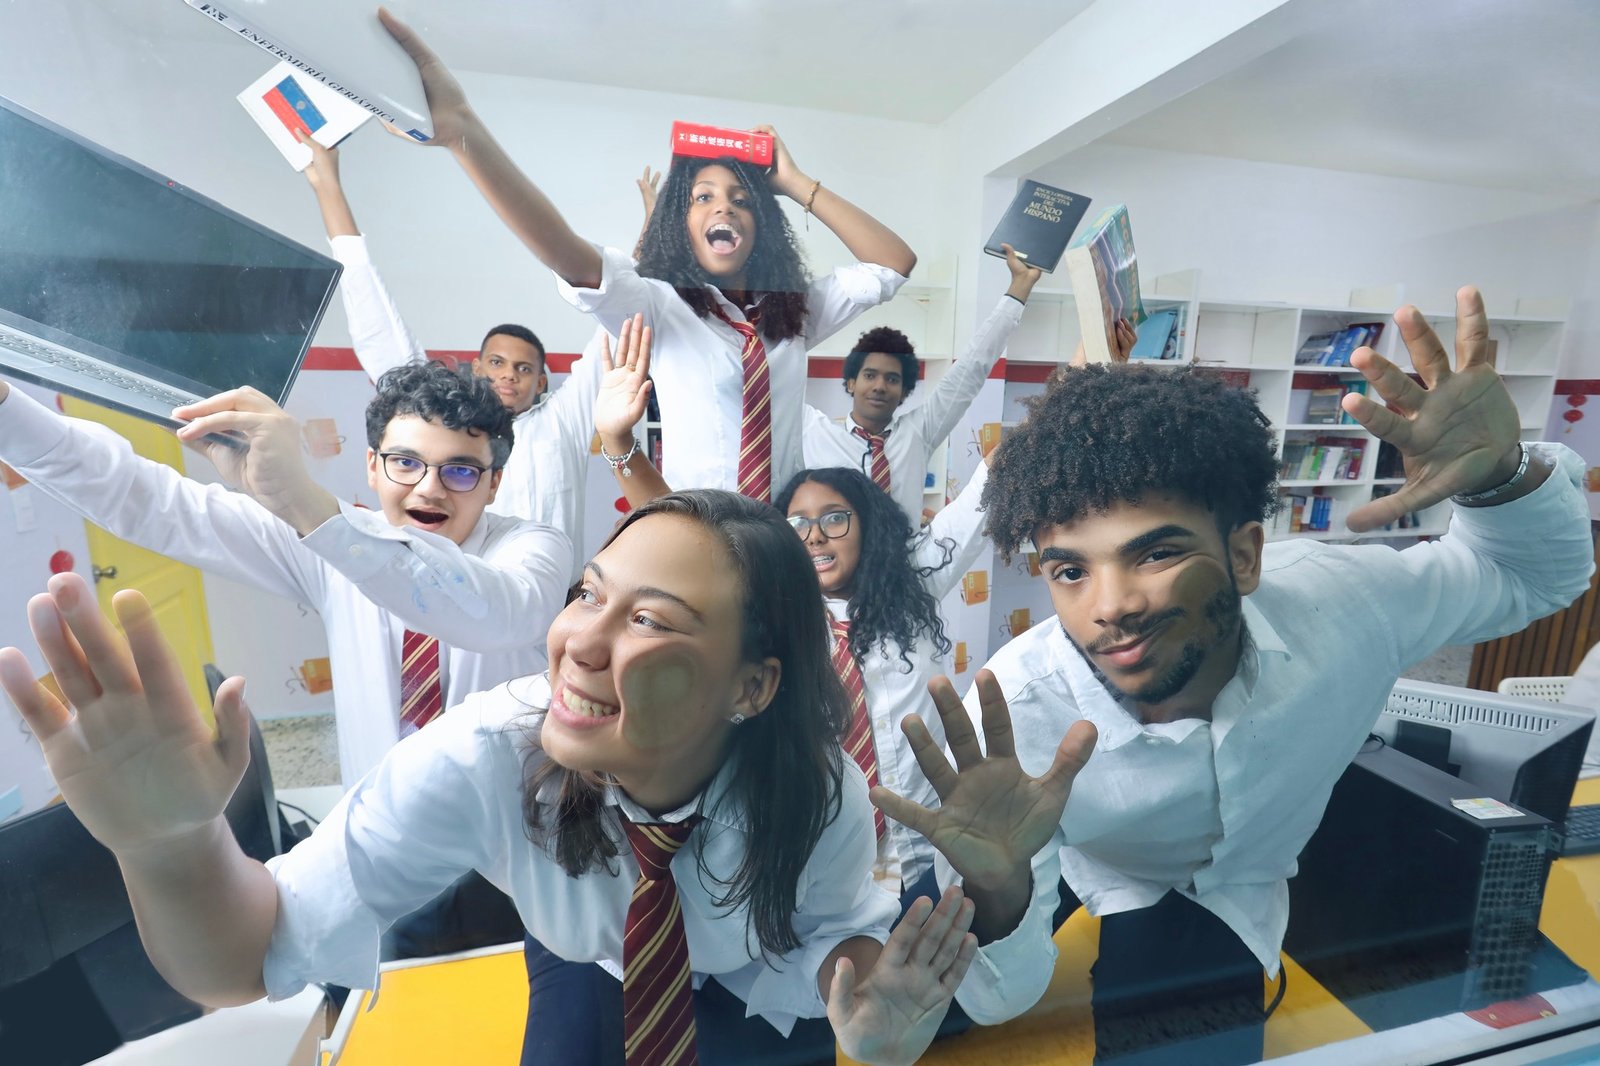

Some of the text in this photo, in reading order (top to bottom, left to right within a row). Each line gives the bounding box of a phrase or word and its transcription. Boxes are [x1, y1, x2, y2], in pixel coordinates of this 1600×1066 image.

[239, 27, 396, 124] ENFERMERÍA GERIÁTRICA
[689, 133, 744, 150] 新华成语词典
[1033, 190, 1070, 206] INTERACTIVA
[1043, 199, 1055, 207] DEL
[1023, 206, 1061, 223] HISPANO
[1029, 200, 1063, 216] MUNDO
